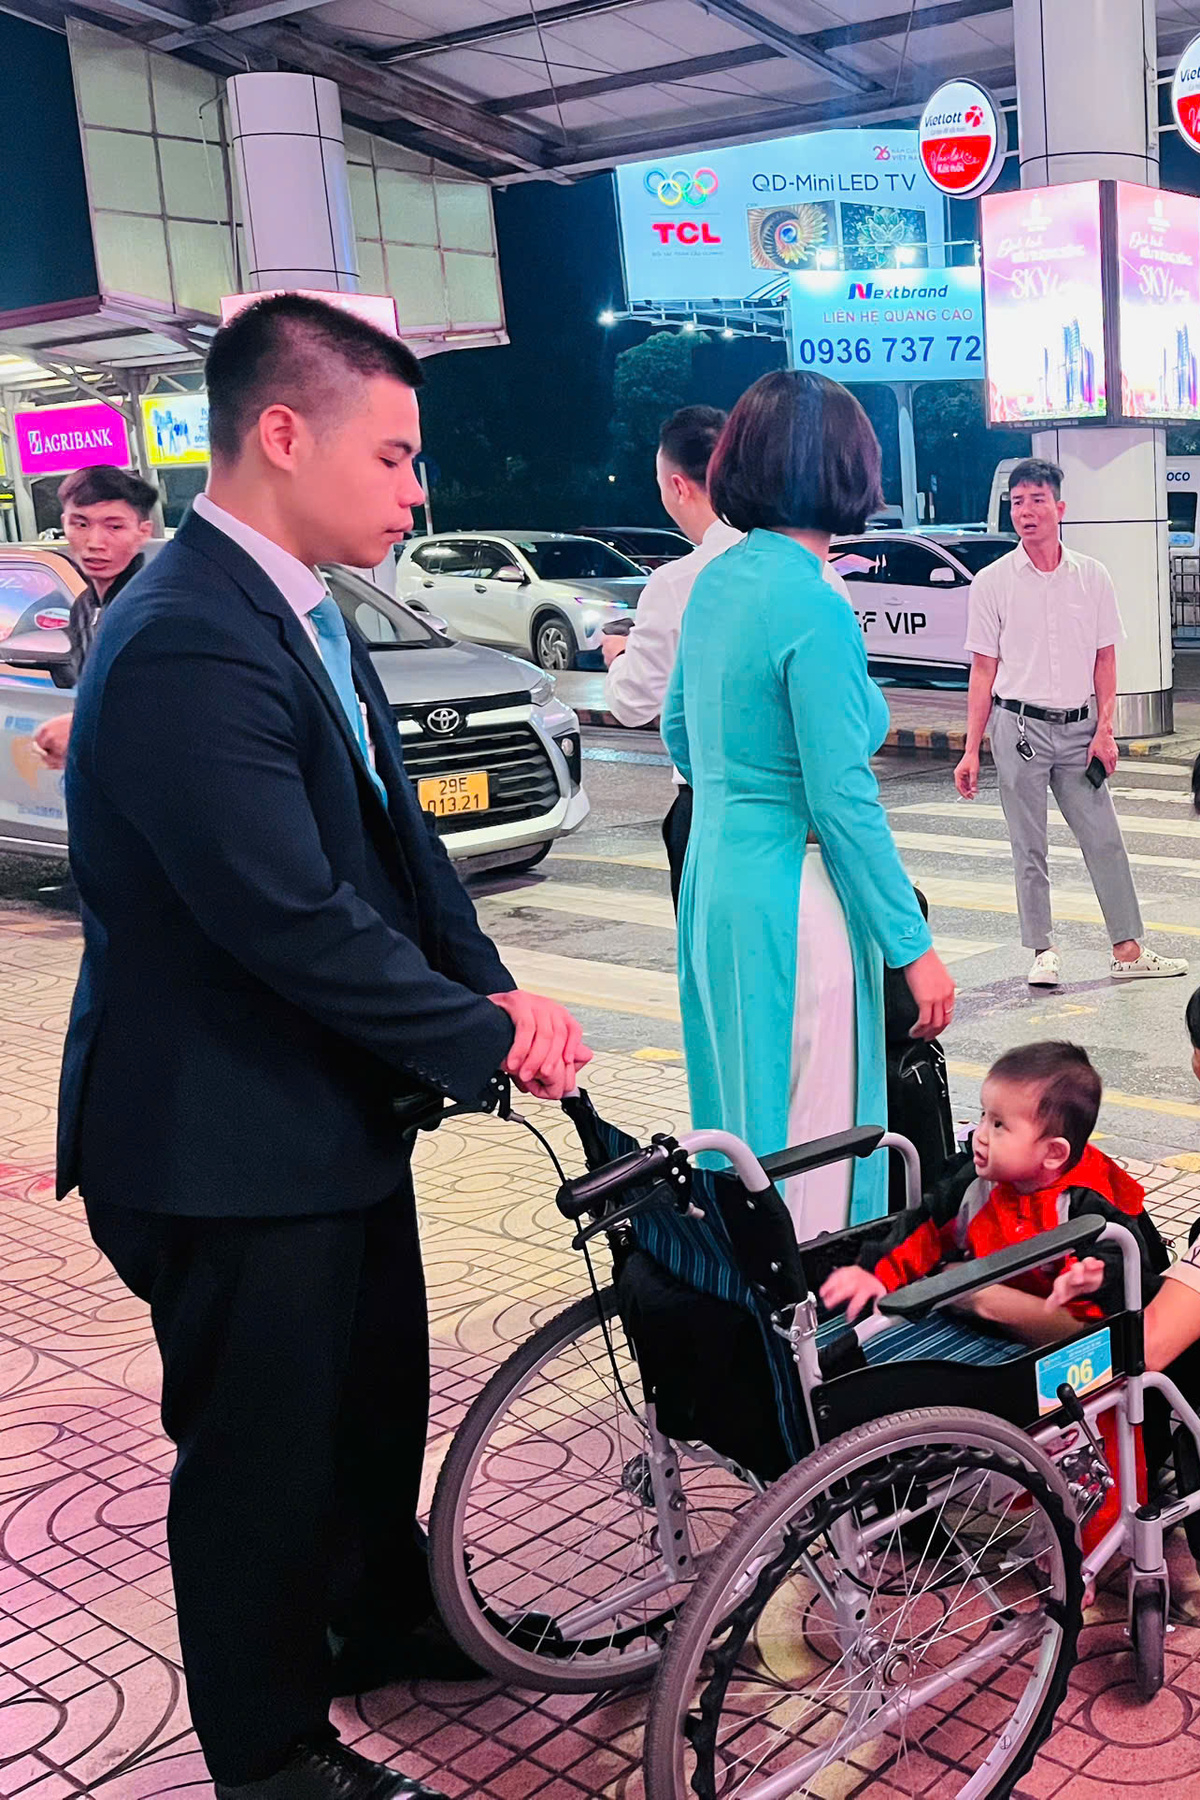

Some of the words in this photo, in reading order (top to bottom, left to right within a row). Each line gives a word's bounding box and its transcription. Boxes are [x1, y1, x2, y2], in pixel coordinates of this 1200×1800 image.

[925, 112, 962, 127] Vietlott
[873, 145, 891, 160] 26
[885, 173, 916, 191] TV
[652, 222, 721, 244] TCL
[848, 282, 948, 300] Nextbrand
[823, 309, 855, 324] LIÊN
[800, 338, 871, 364] 0936
[882, 336, 934, 363] 737
[946, 335, 981, 362] 72
[44, 428, 113, 453] AGRIBANK
[885, 612, 926, 634] VIP
[439, 777, 468, 795] 29E
[428, 794, 479, 814] 013.21
[1066, 1358, 1093, 1390] 06
